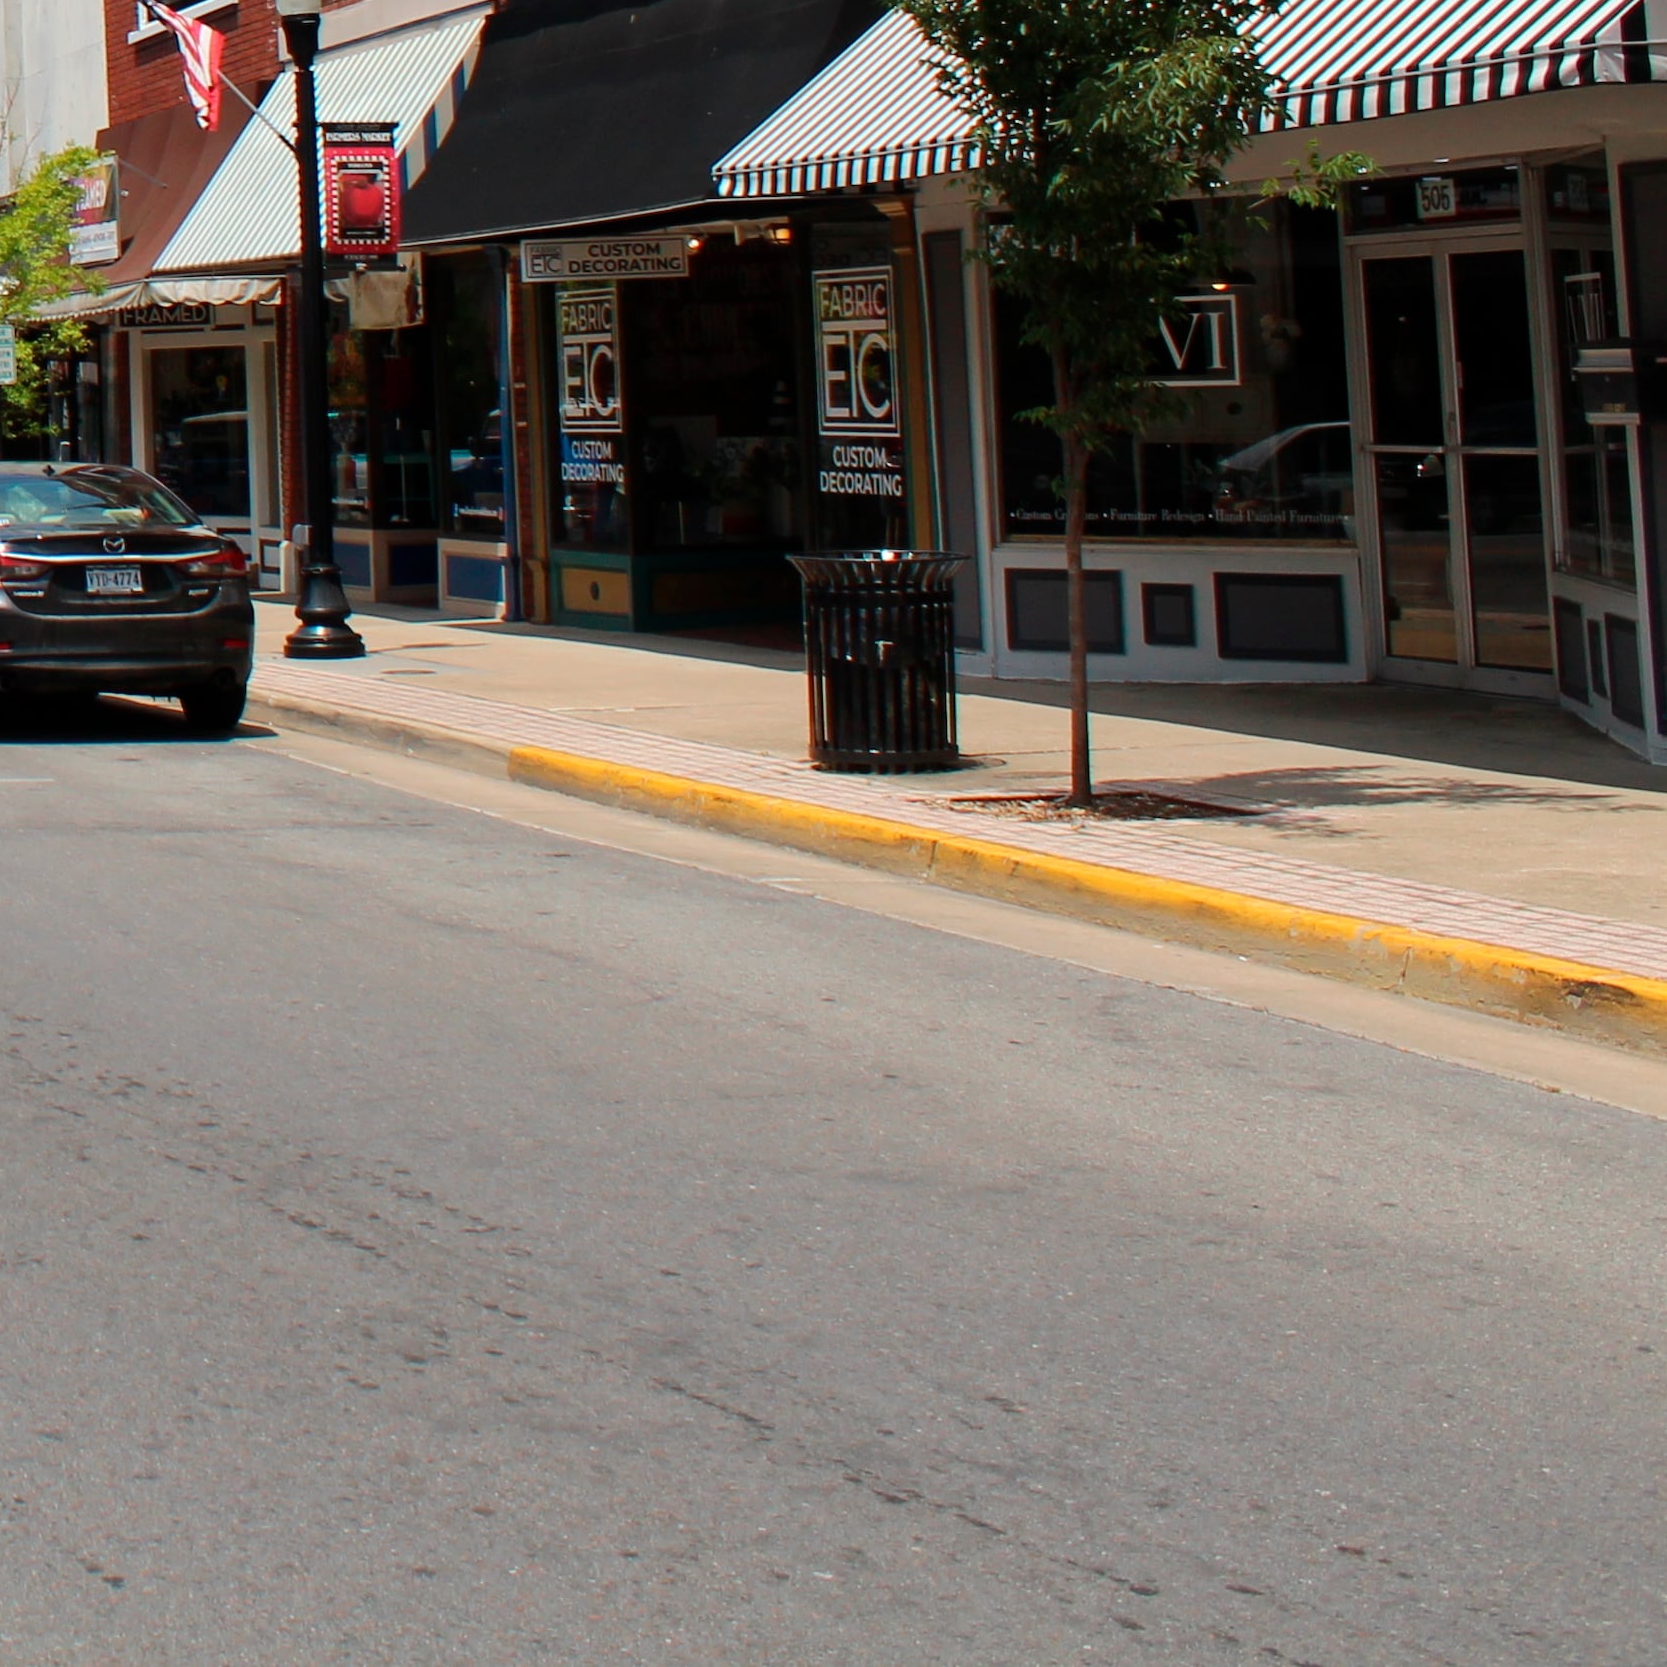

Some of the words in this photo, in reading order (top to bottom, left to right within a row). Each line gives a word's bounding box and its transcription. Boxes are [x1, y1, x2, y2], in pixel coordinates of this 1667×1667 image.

[1420, 185, 1450, 212] 505
[587, 242, 660, 258] CUSTOM
[530, 253, 563, 273] ETC
[568, 256, 681, 274] DECORATING
[820, 283, 887, 318] FABRIC
[123, 303, 207, 325] FRAMED
[561, 302, 613, 333] FABRIC
[563, 333, 615, 417] ETC
[822, 319, 891, 419] ETC
[571, 440, 613, 461] CUSTOM
[832, 445, 888, 469] CUSTOM
[560, 461, 625, 483] DECORATING
[820, 470, 903, 497] DECORATING
